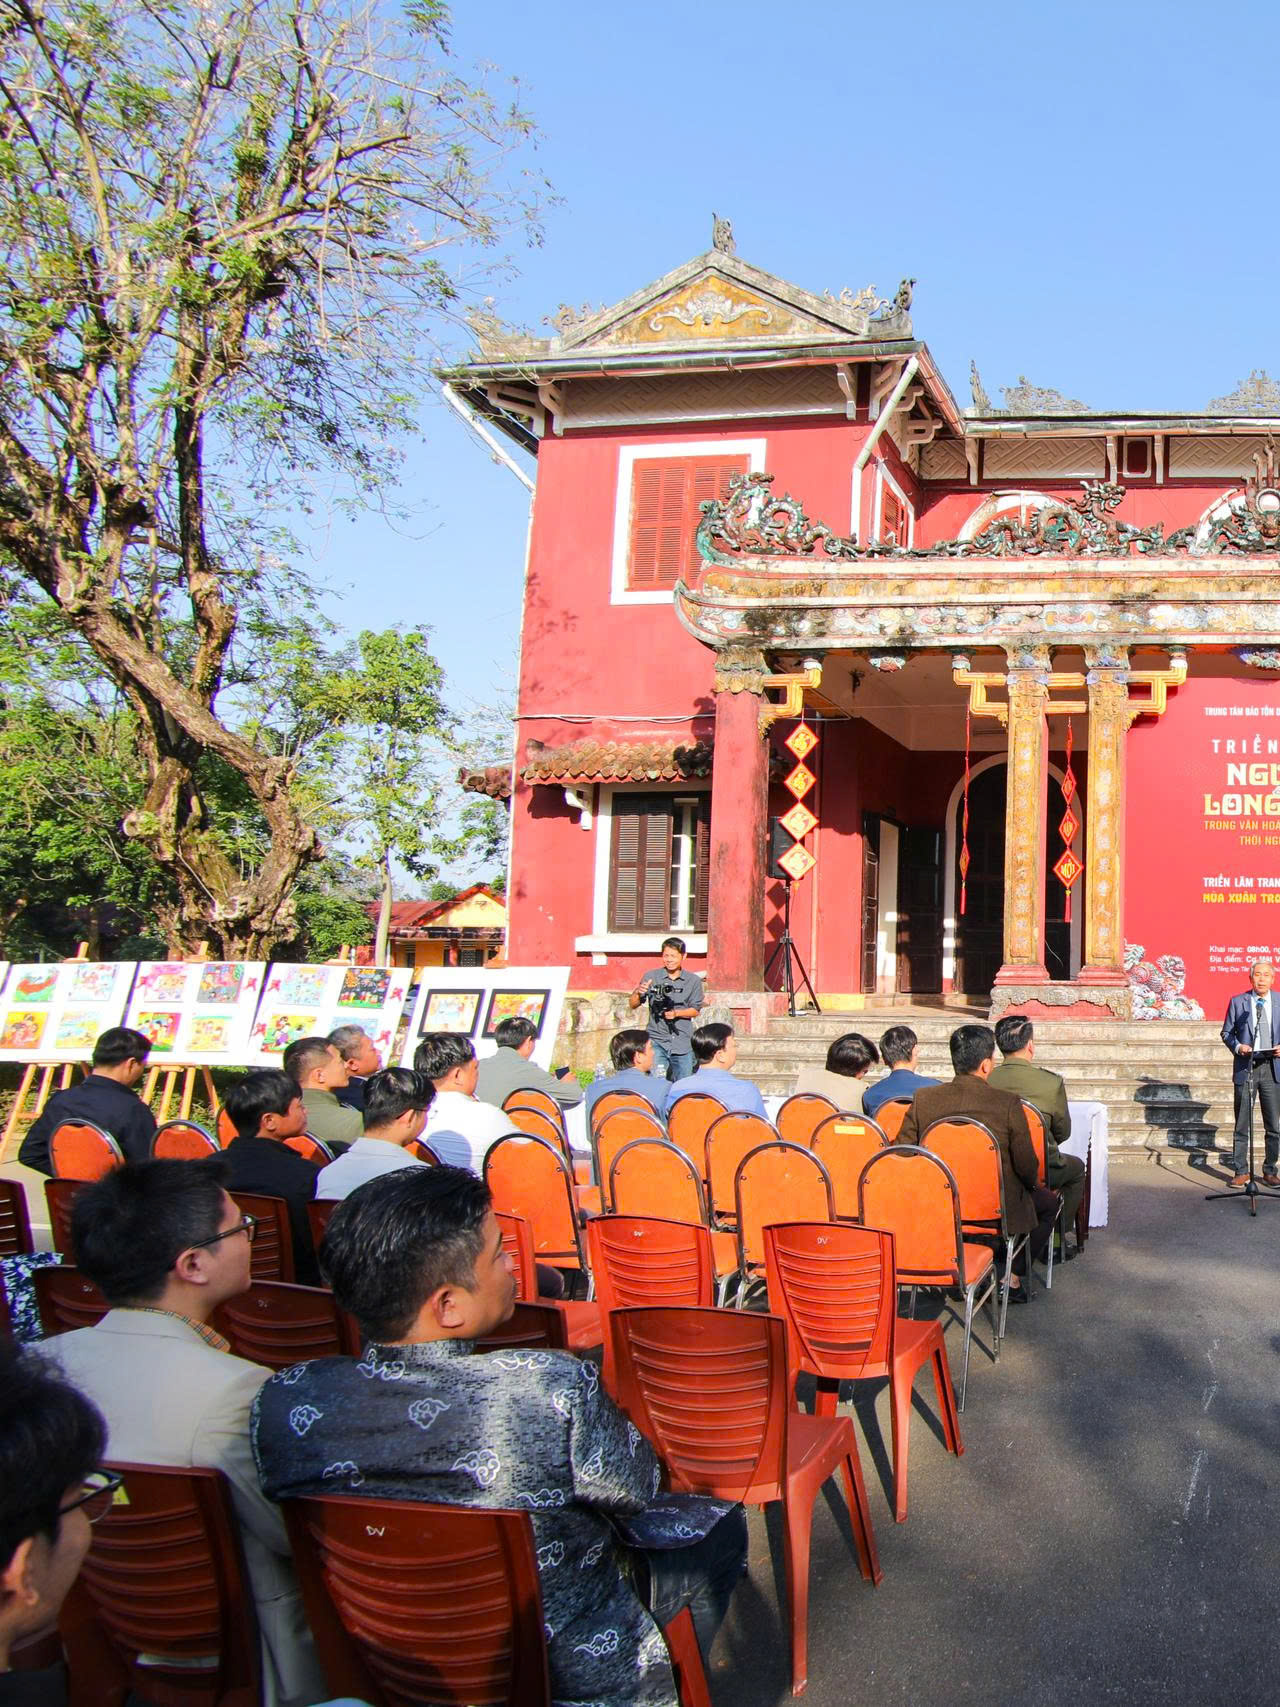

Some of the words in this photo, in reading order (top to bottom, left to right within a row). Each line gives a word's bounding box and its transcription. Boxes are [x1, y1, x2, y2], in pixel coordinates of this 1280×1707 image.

[1211, 733, 1279, 755] TRIỂN
[1204, 820, 1236, 831] TRONG
[1234, 875, 1254, 888] LÃM
[1209, 945, 1226, 953] Khai
[366, 1525, 385, 1537] DV
